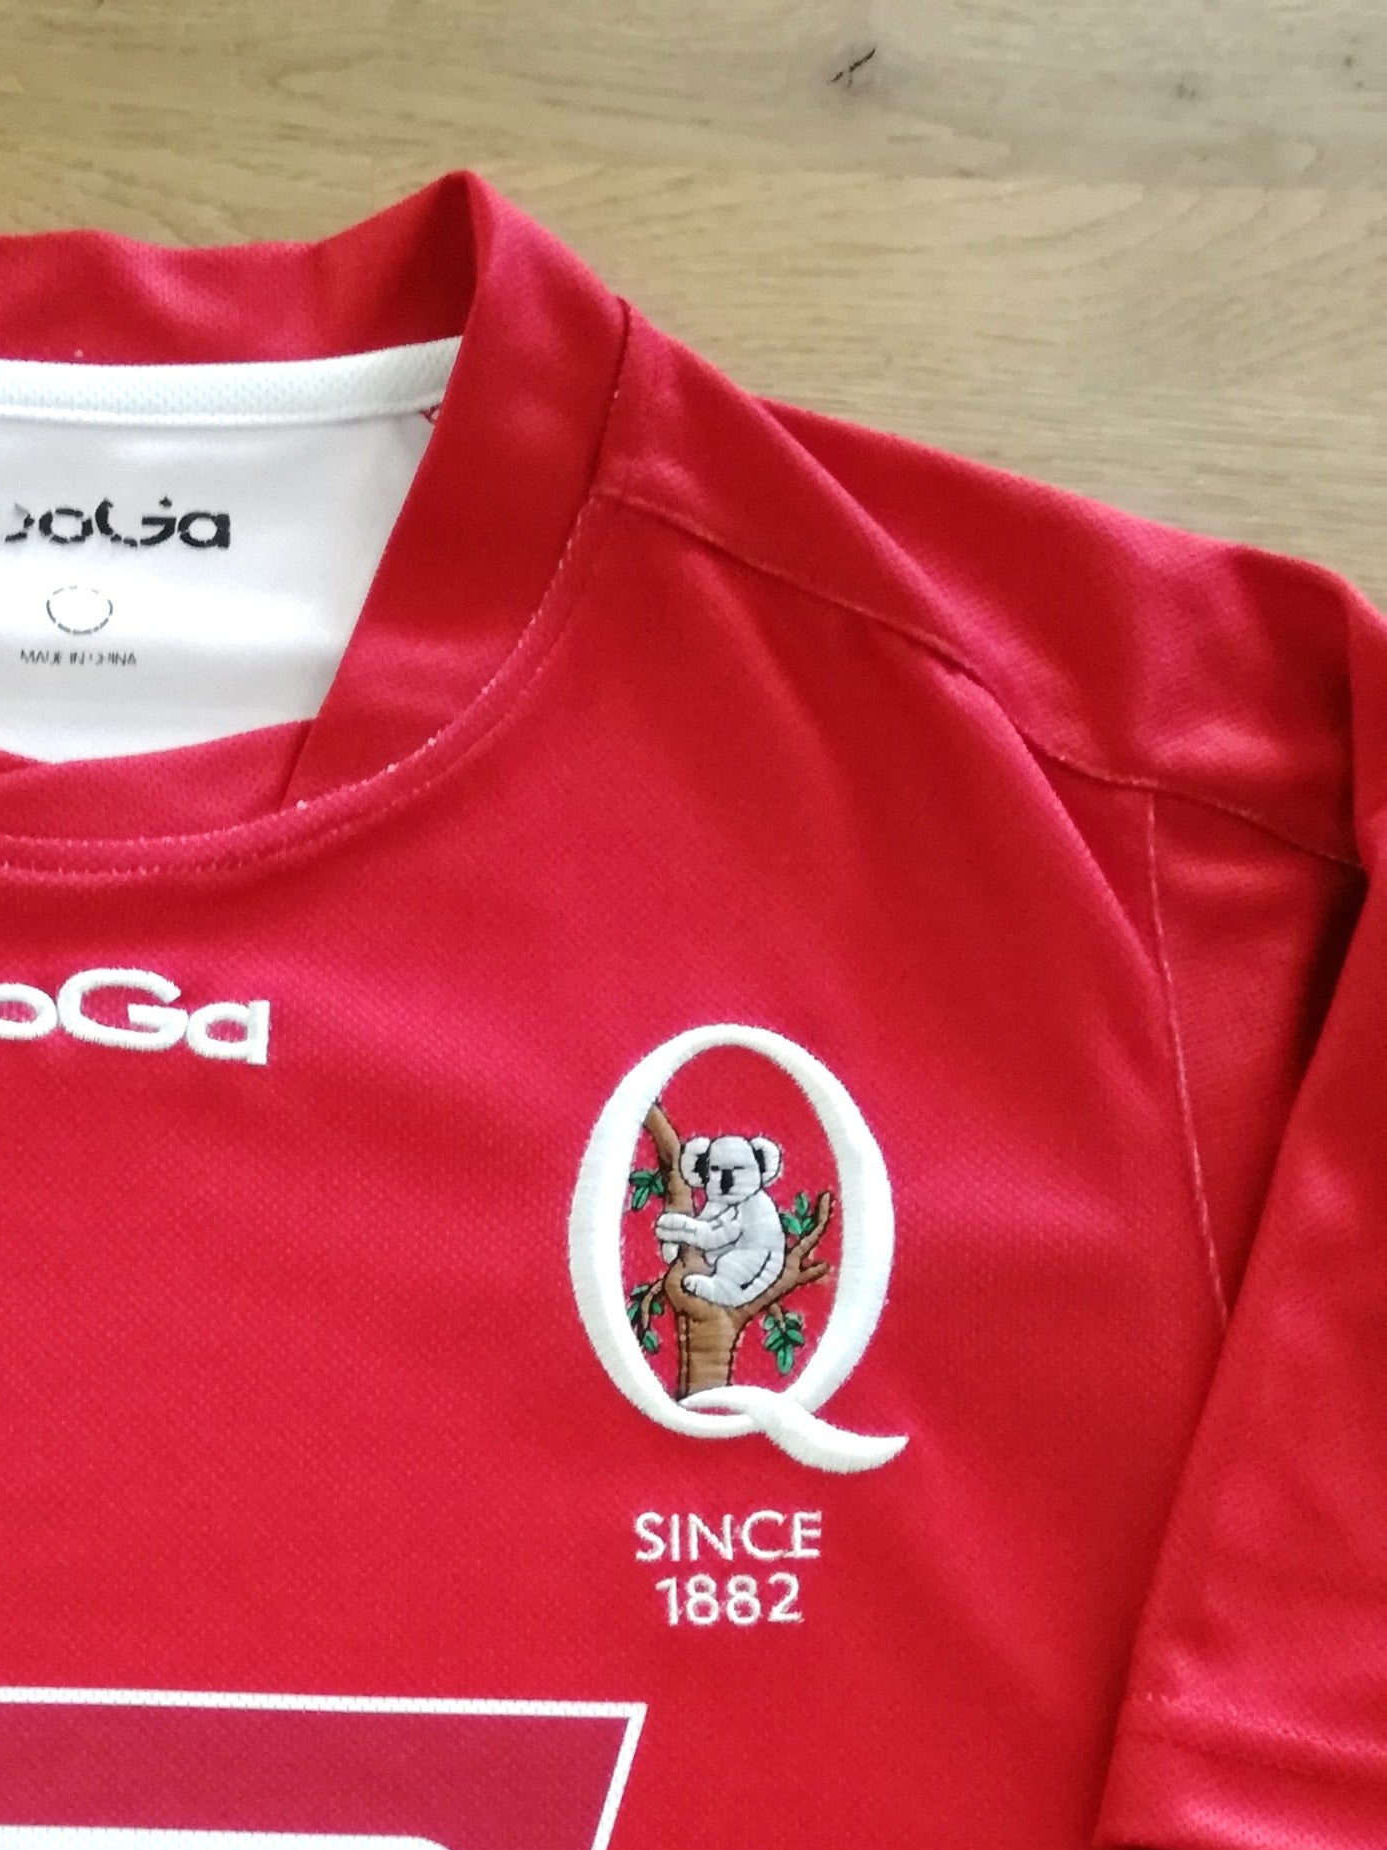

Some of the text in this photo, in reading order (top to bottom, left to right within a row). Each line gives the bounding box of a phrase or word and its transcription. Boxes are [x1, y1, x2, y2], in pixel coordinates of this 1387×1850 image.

[567, 1022, 910, 1475] Q
[633, 1509, 823, 1563] SINCE
[654, 1570, 805, 1628] 1882
